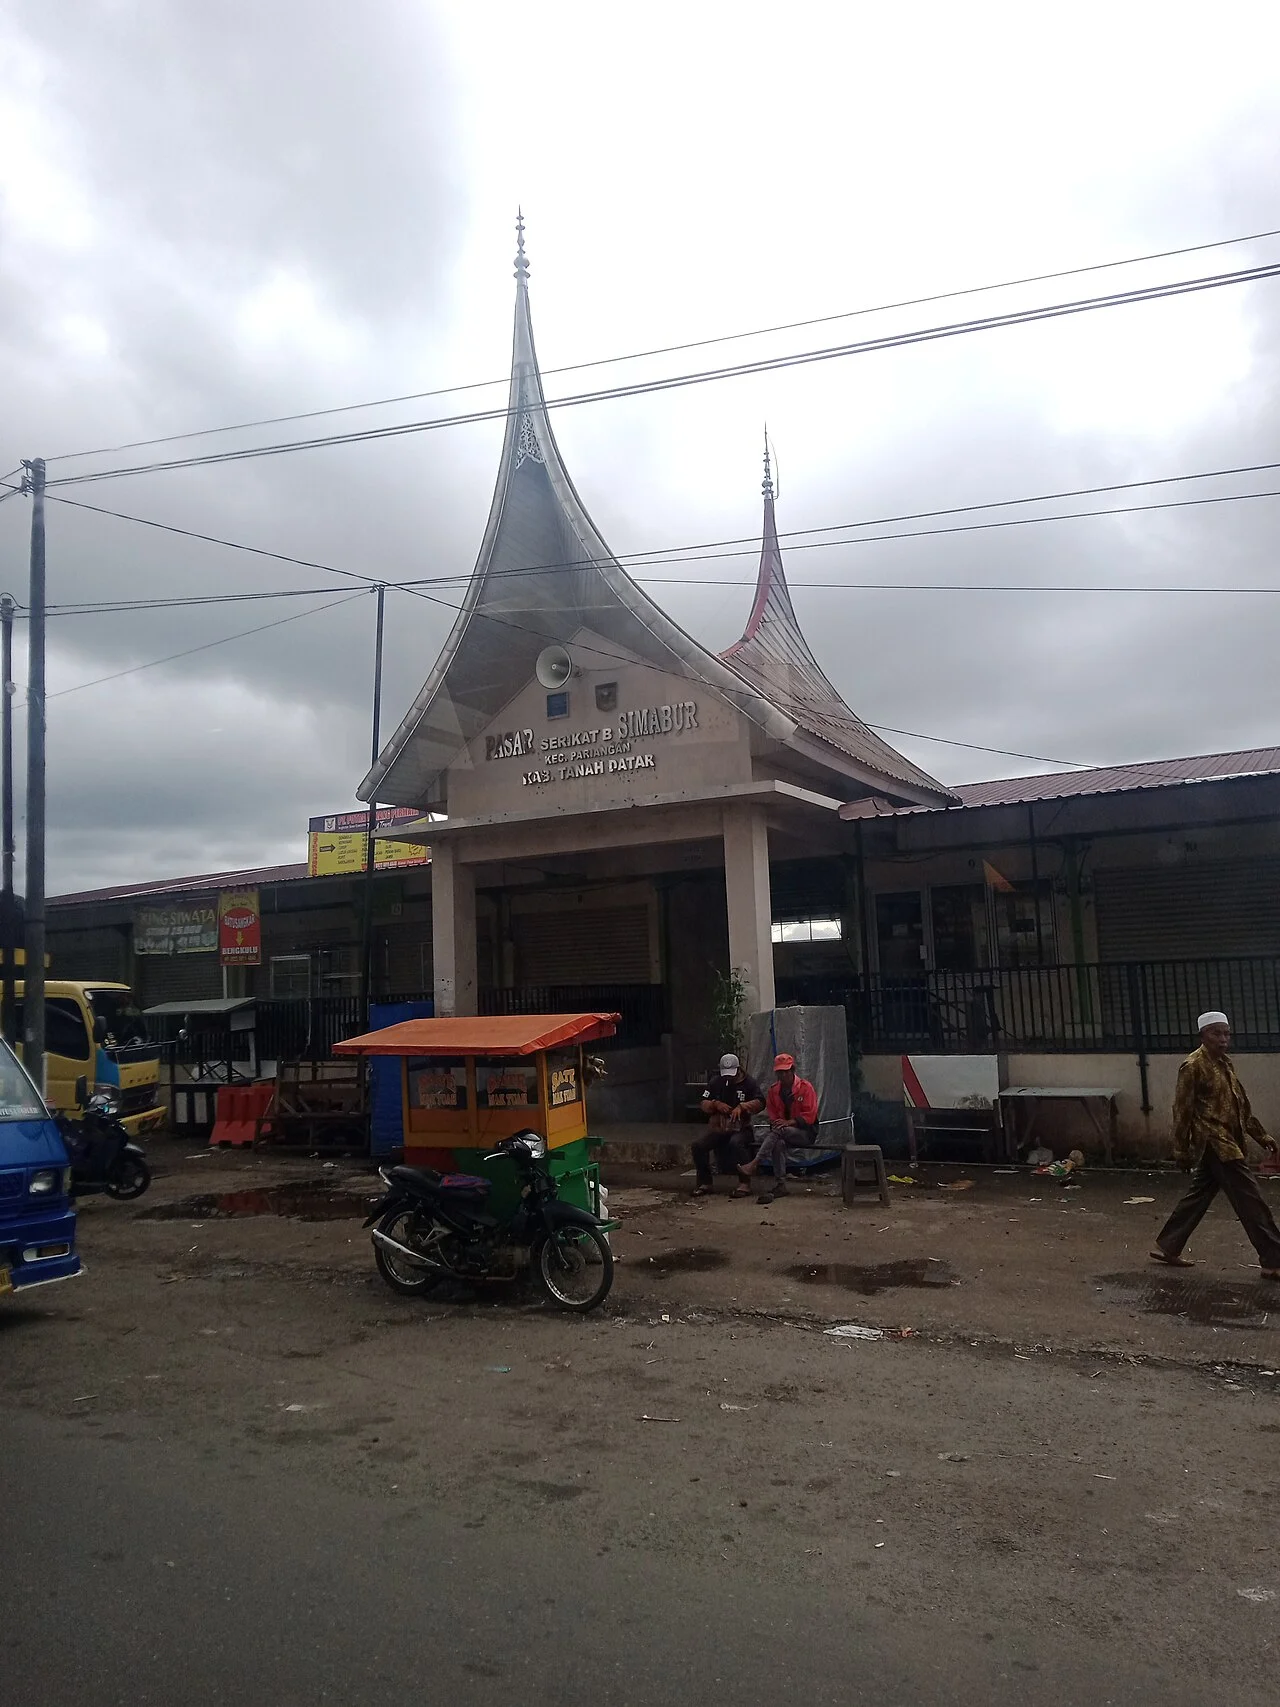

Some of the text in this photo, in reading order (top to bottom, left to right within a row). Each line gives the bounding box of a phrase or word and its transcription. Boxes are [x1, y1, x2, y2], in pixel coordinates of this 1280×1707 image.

[486, 701, 698, 760] PASAR SERIKAT B SIMABUR
[544, 742, 631, 765] KEC. PARIANGAN
[522, 754, 655, 786] KAB. TANAH DATAR
[224, 914, 256, 928] BATUSANGKAR
[222, 946, 258, 954] BENGKULU
